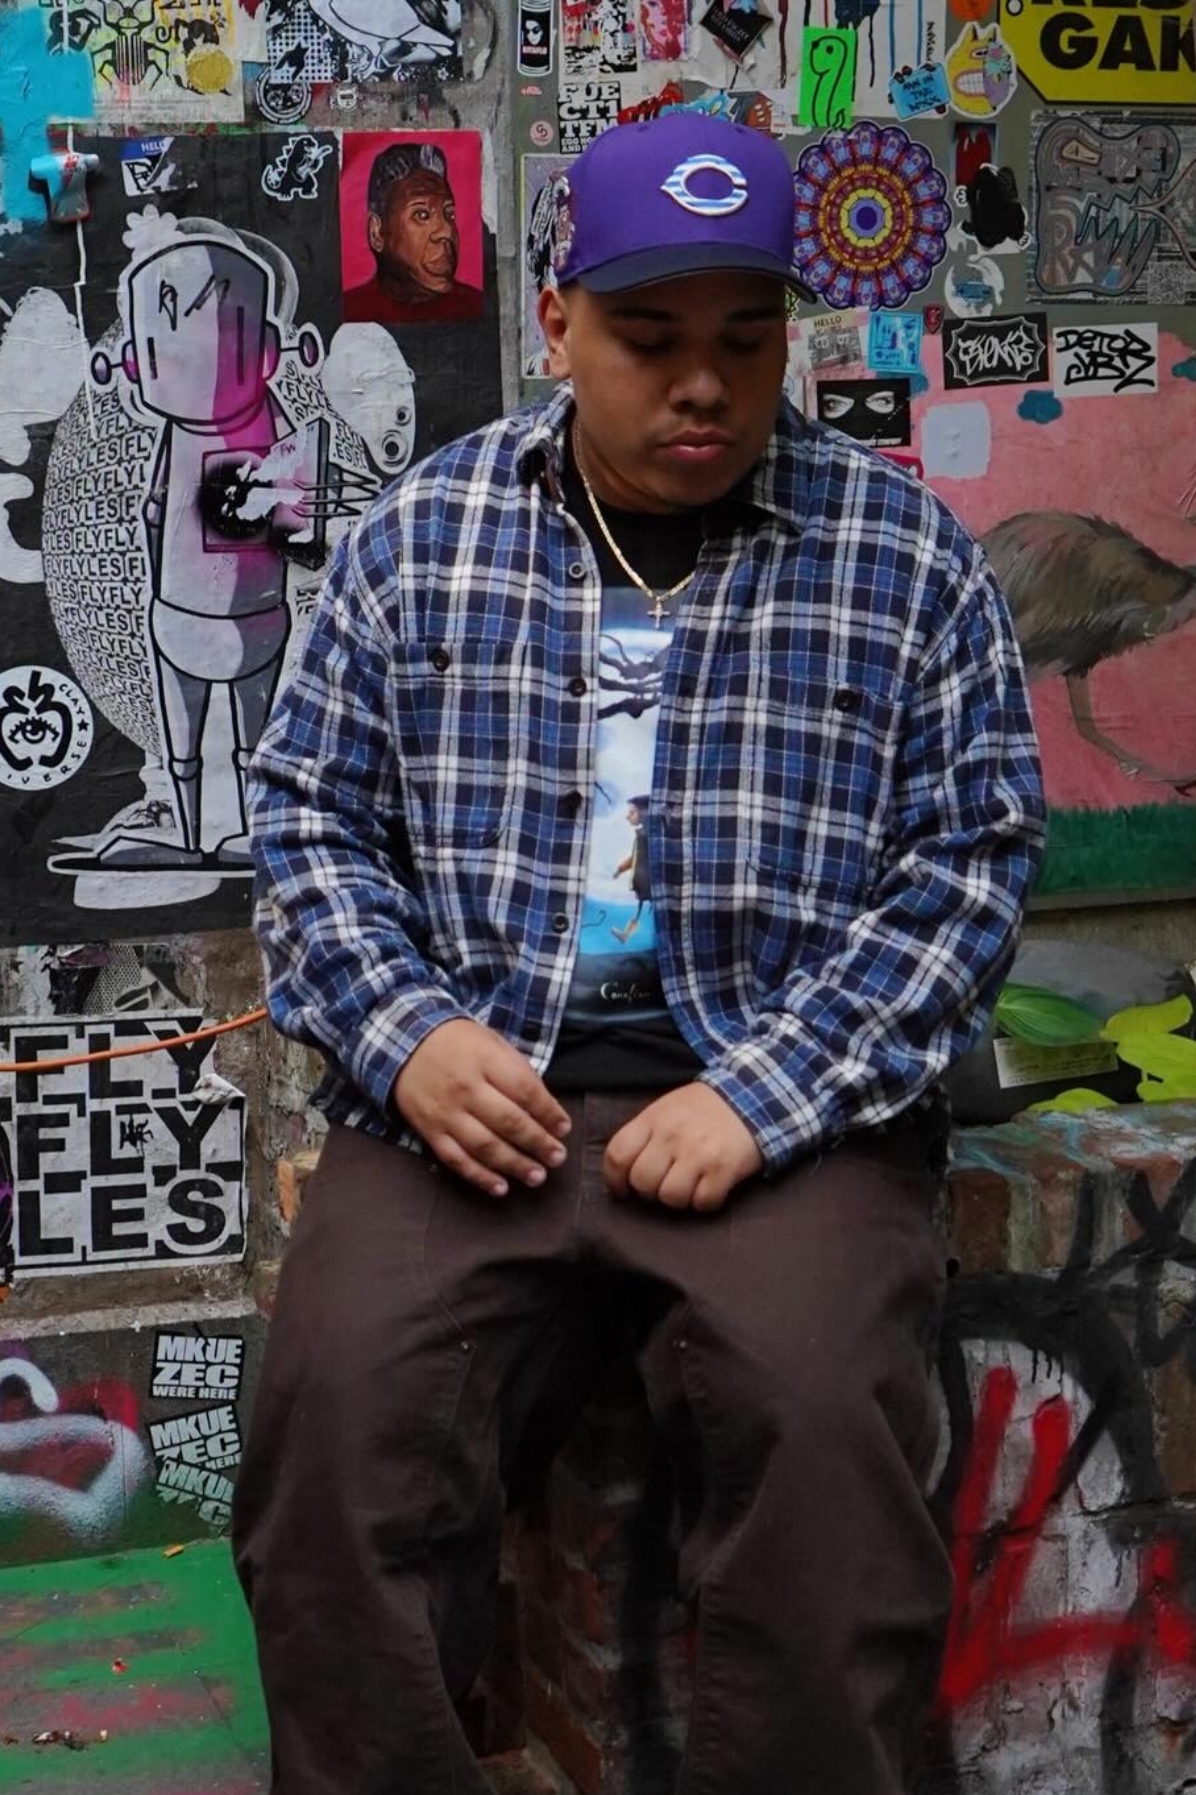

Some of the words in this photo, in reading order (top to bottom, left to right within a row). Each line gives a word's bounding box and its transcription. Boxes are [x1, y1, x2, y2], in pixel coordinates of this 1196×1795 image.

[814, 316, 842, 328] HELLO
[15, 1027, 218, 1102] FLY
[16, 1104, 227, 1181] FLY
[18, 1179, 227, 1257] LES
[157, 1335, 243, 1364] MKUE
[152, 1361, 240, 1388] ZEC
[152, 1385, 196, 1398] WERE
[198, 1386, 237, 1401] HERE
[150, 1404, 237, 1449] MKUE
